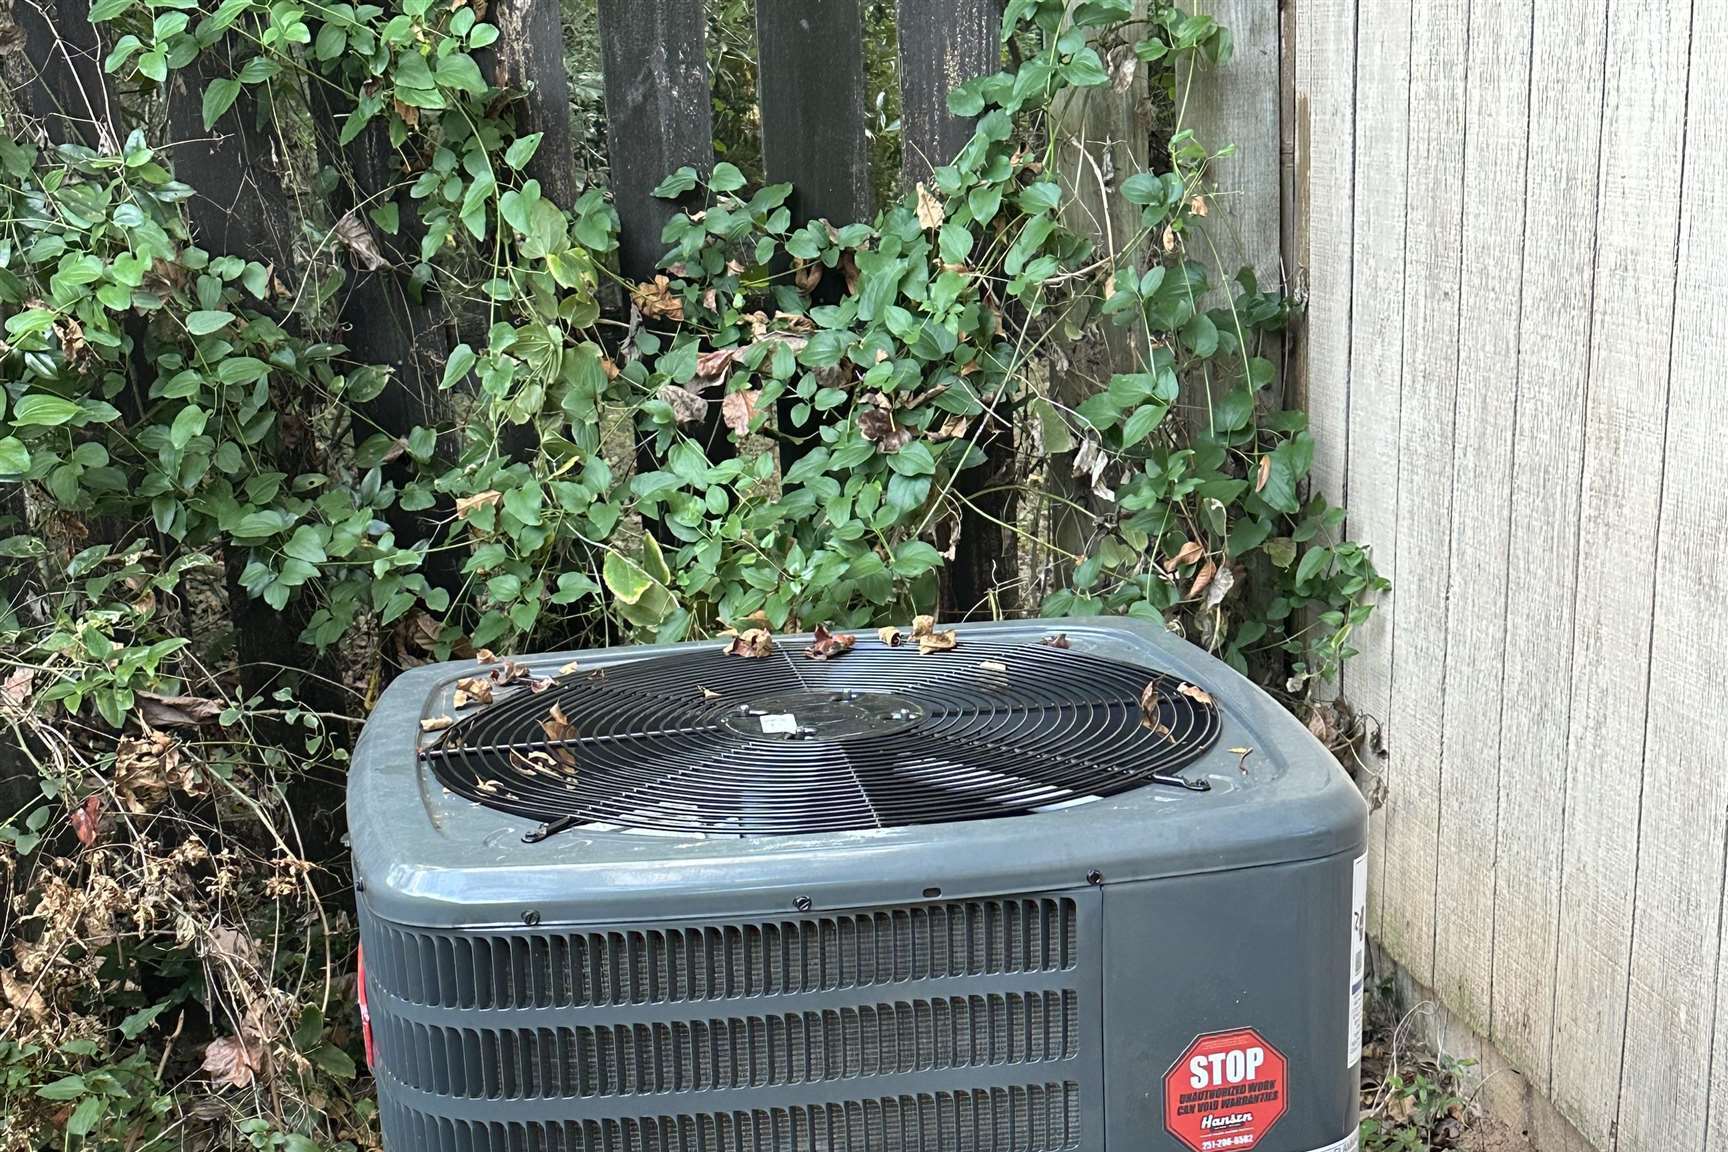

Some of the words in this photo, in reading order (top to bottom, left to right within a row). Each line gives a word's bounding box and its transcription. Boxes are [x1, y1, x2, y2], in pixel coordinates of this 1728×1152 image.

[1190, 1047, 1264, 1089] STOP
[1247, 1080, 1276, 1093] WORK
[1198, 1100, 1219, 1113] VOID
[1221, 1091, 1279, 1109] WARRANTIES
[1201, 1112, 1253, 1129] Hansen
